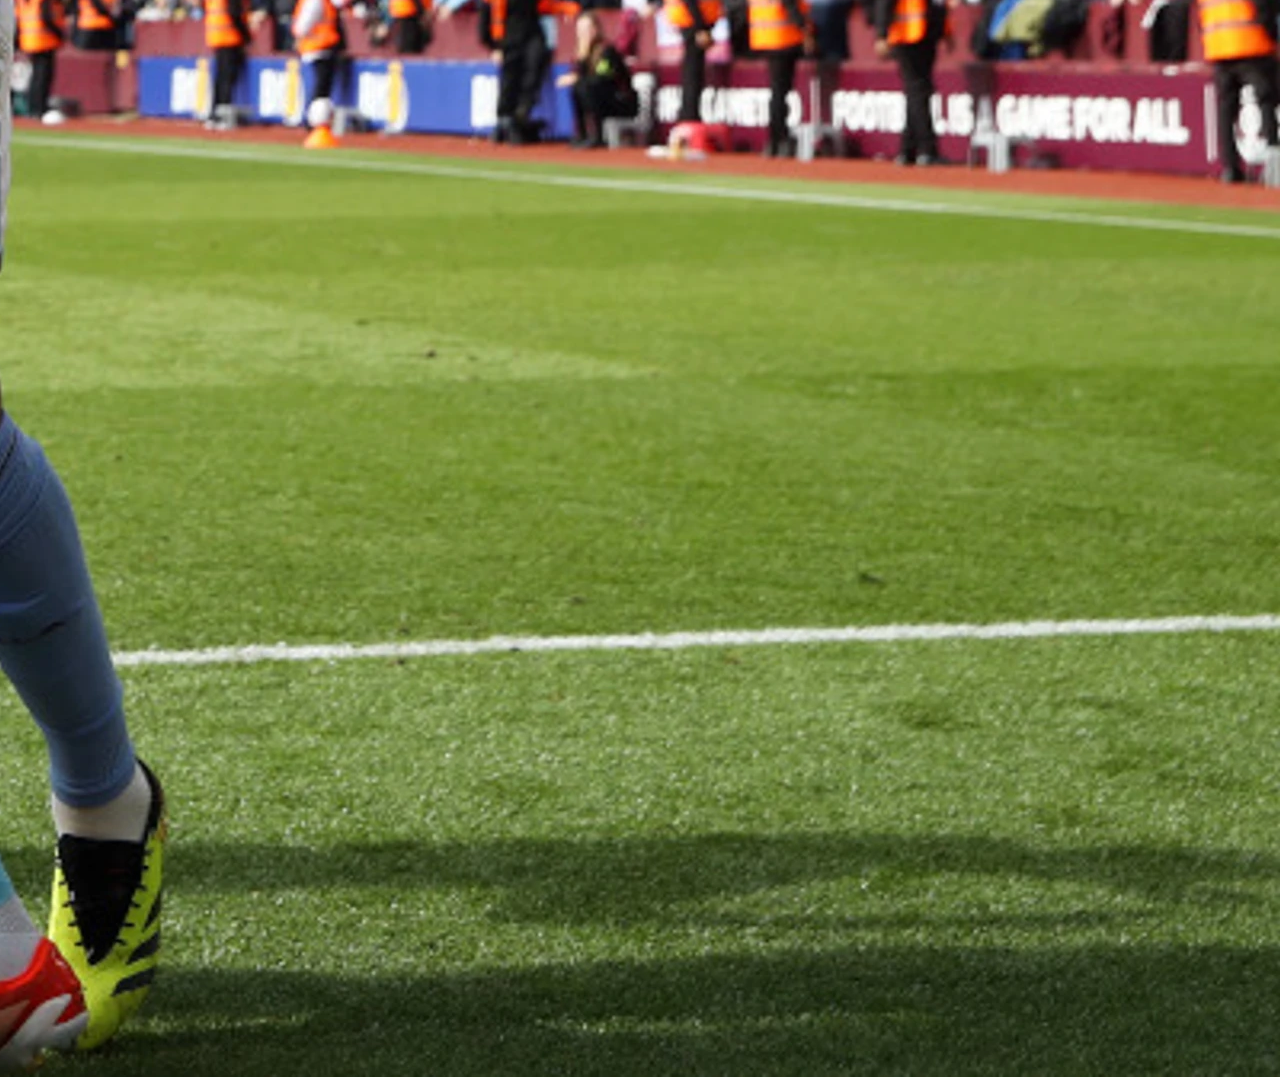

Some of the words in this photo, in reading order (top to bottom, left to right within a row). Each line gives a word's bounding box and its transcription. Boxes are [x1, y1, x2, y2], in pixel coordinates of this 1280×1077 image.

[996, 94, 1071, 140] GAME
[1073, 95, 1132, 142] FOR
[1133, 97, 1190, 144] ALL
